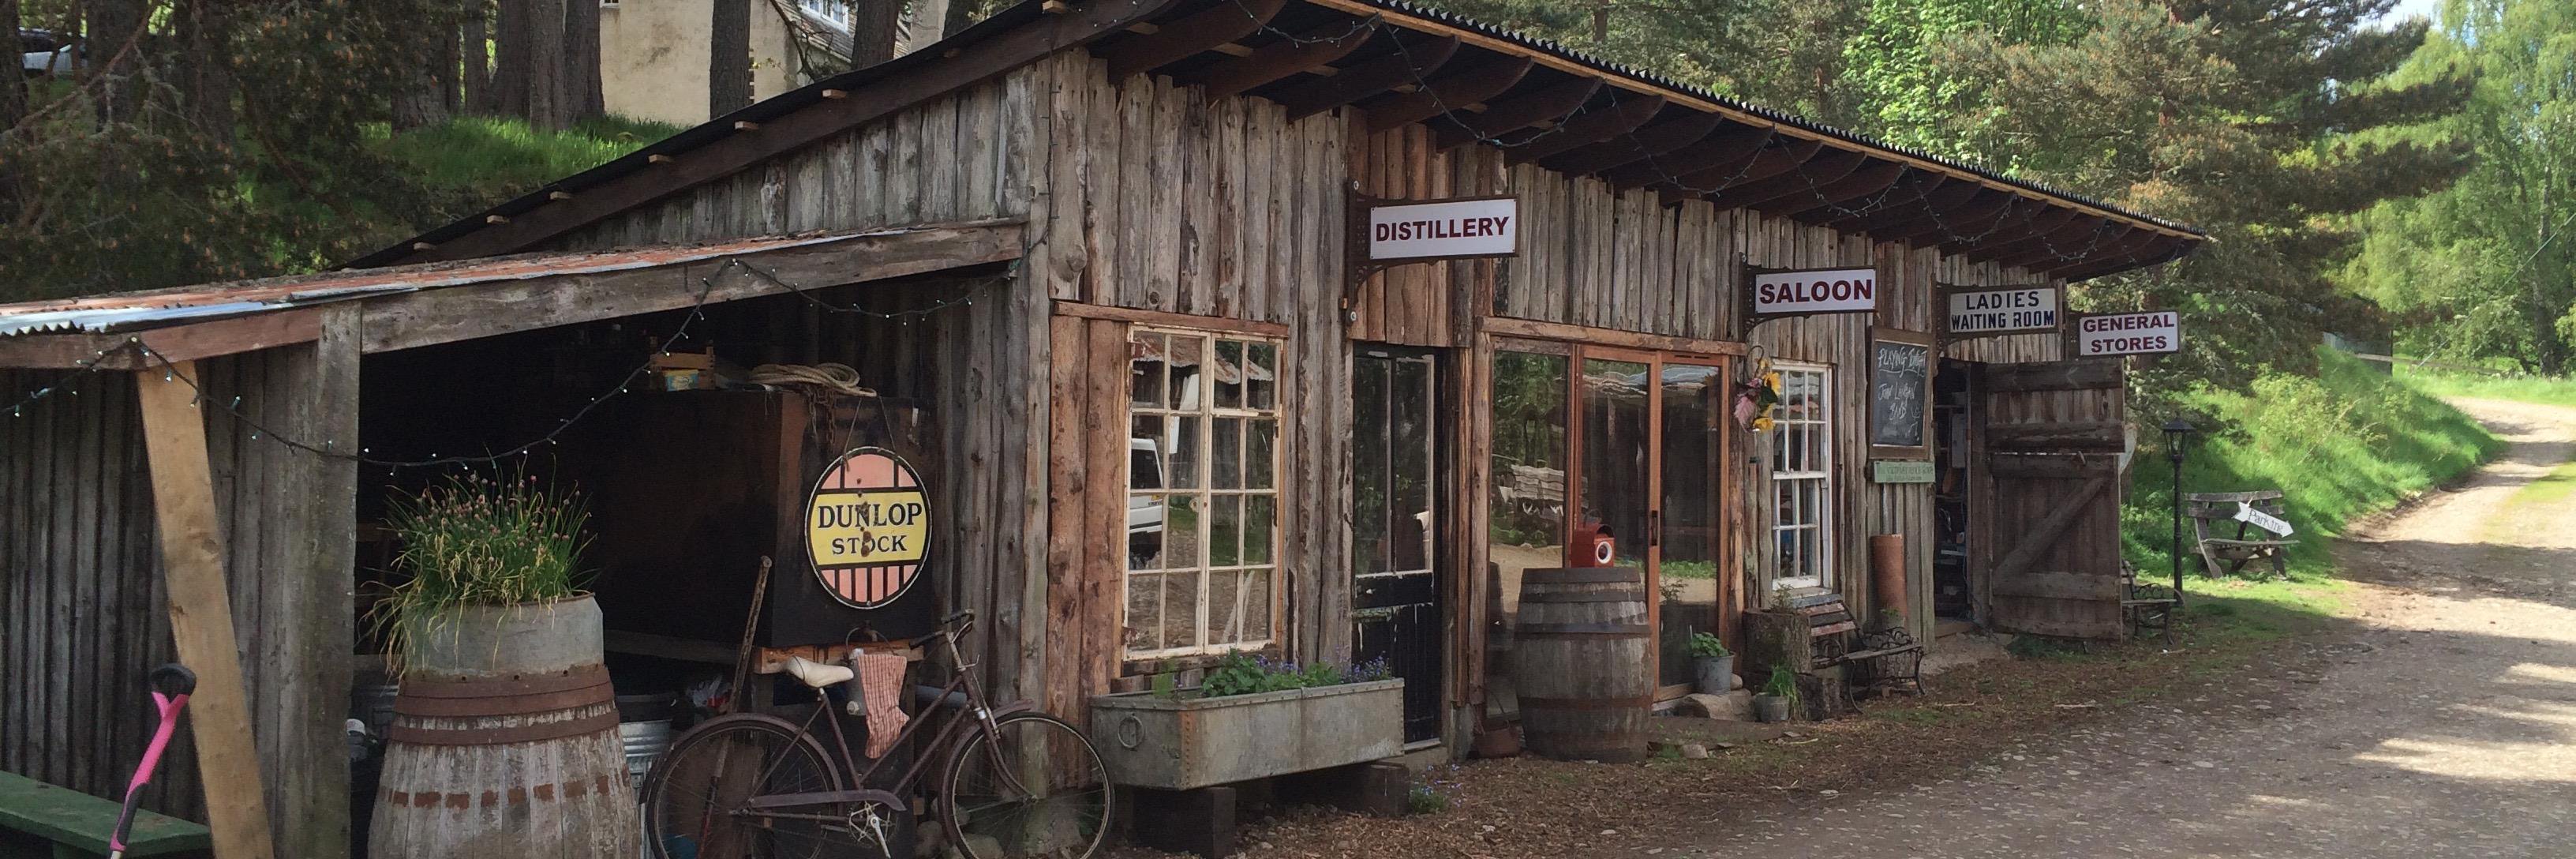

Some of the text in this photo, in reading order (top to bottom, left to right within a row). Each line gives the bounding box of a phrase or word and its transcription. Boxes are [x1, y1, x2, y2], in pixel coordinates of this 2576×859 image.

[1376, 216, 1510, 242] DISTILLERY
[1759, 279, 1872, 305] SALOON
[1966, 291, 2039, 310] LADIES
[1951, 310, 2054, 330] WAITING ROOM
[2083, 314, 2175, 333] GENERAL
[2091, 336, 2167, 353] STORES
[818, 502, 923, 529] DUNLOP
[832, 535, 908, 555] STOCK
